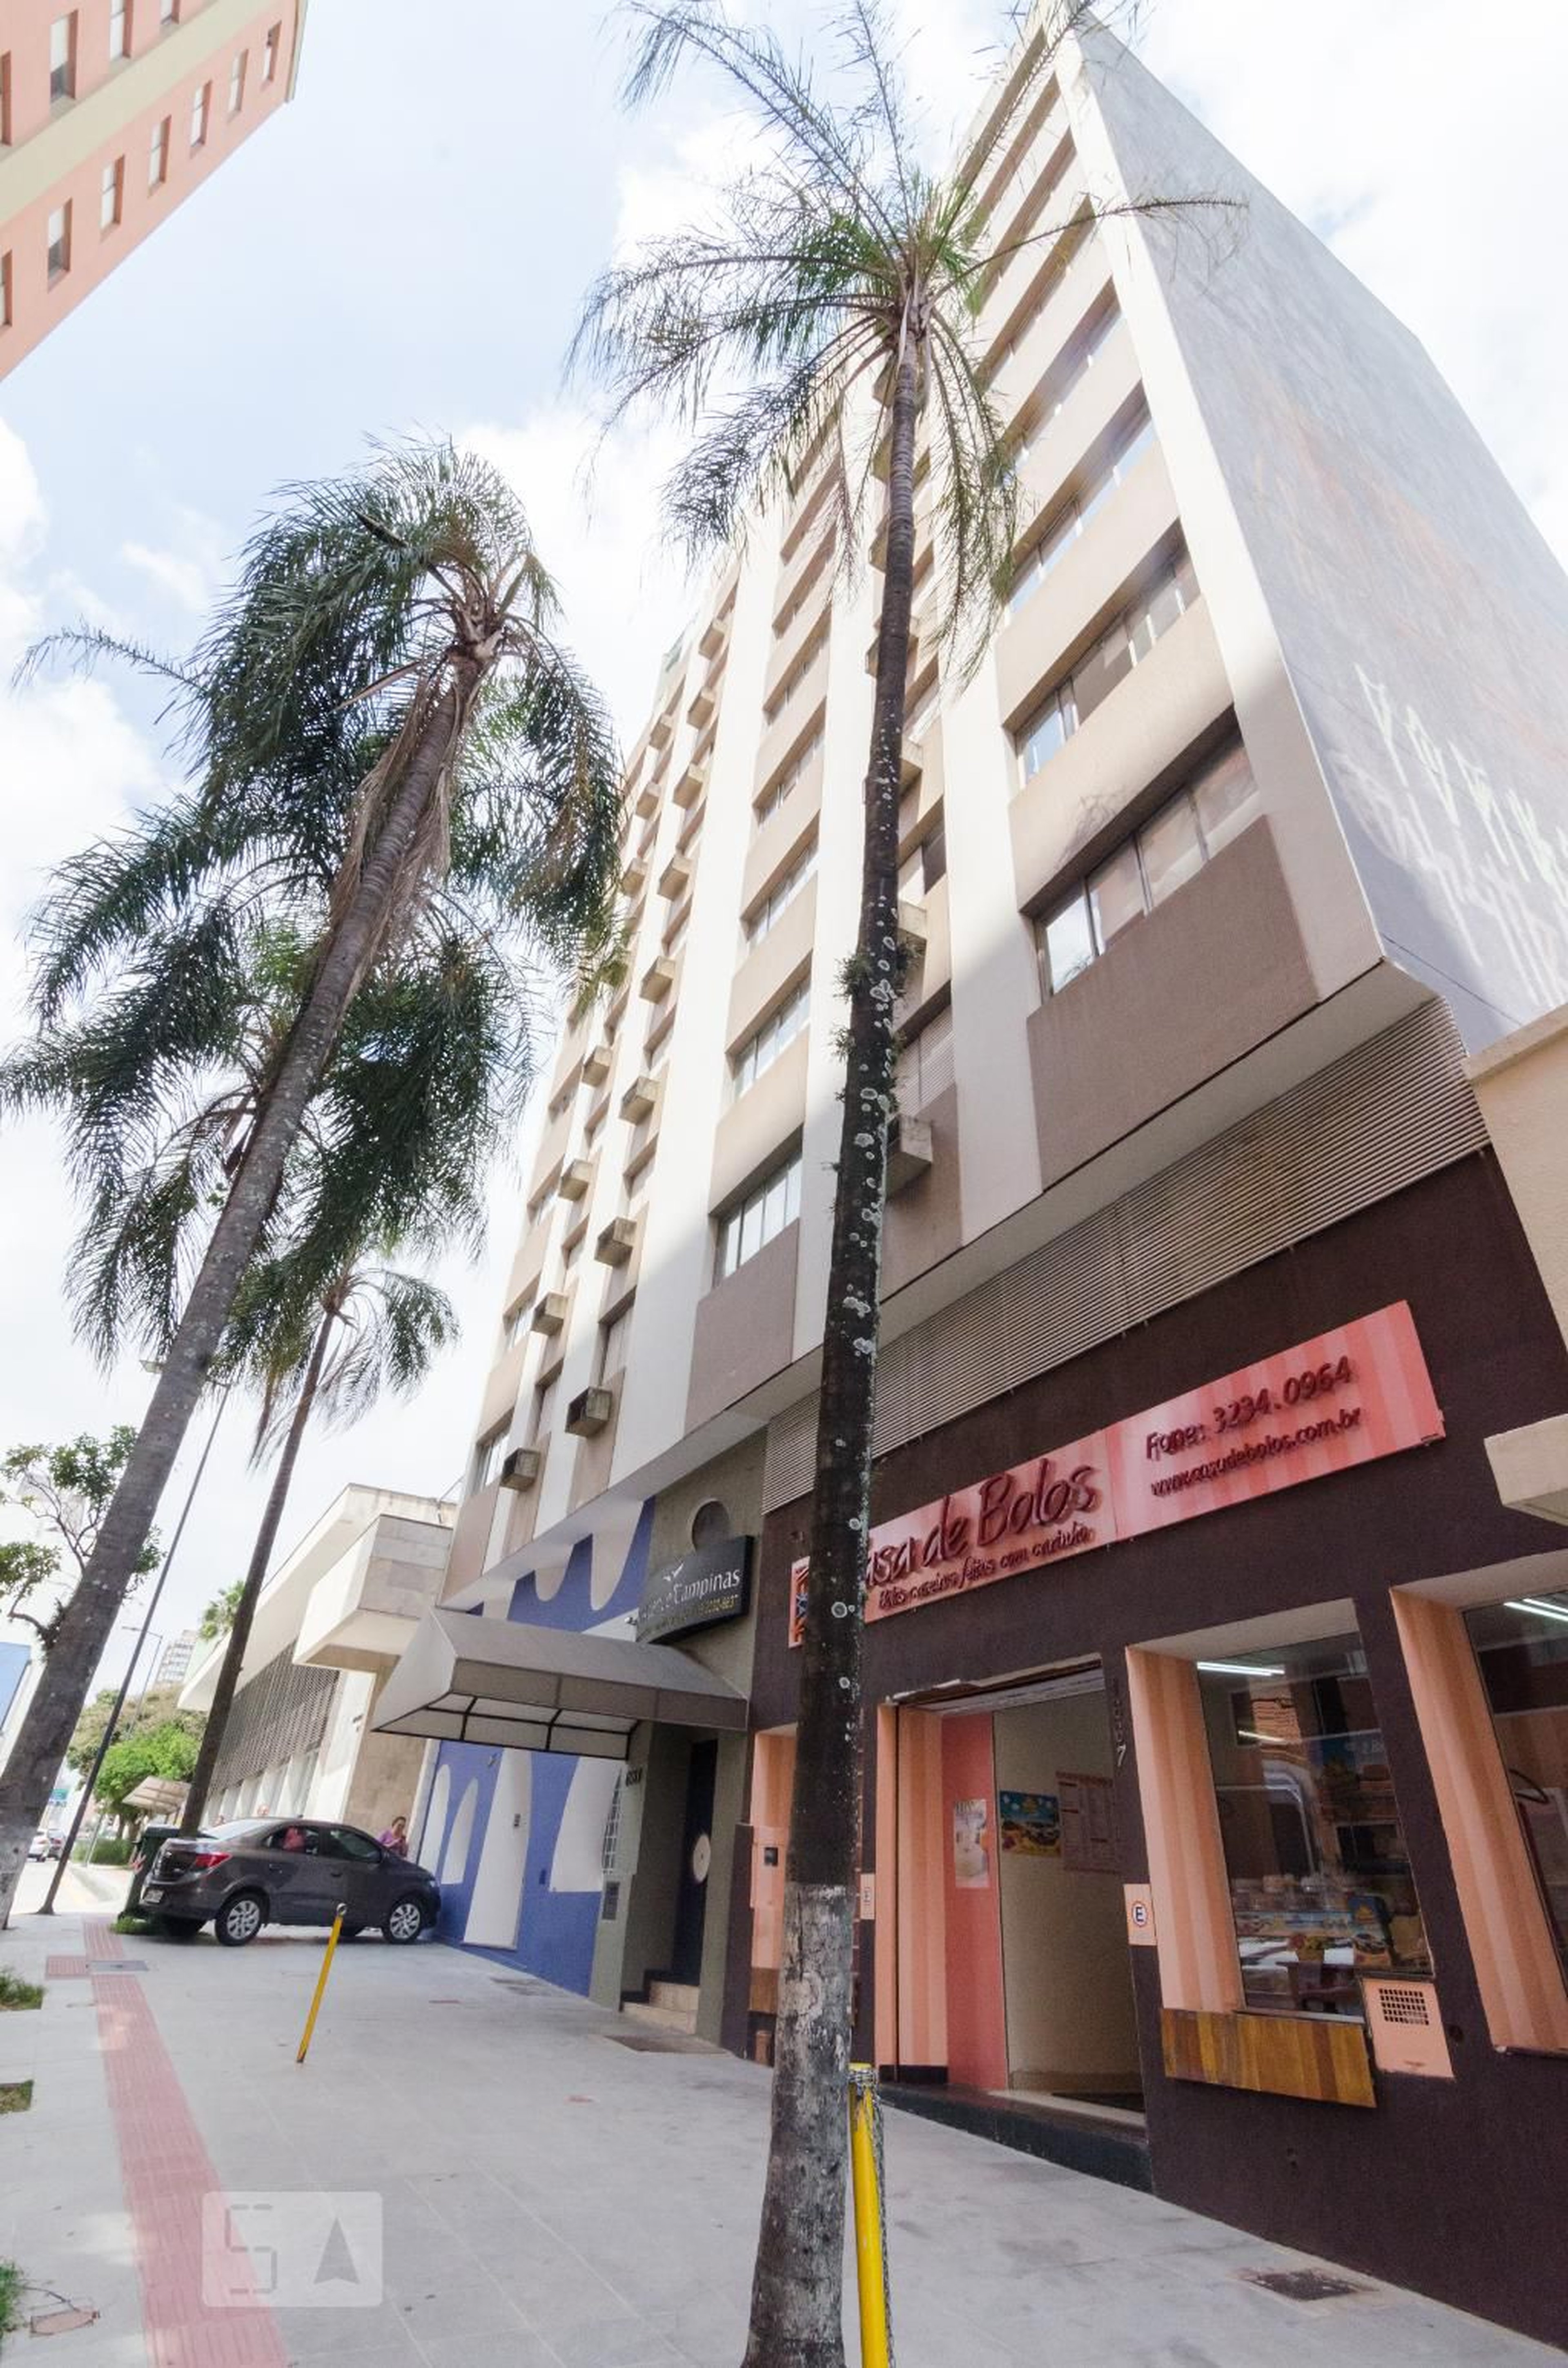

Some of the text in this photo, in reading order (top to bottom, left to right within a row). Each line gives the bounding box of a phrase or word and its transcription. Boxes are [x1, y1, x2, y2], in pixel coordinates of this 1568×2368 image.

[1213, 1356, 1355, 1433] 3234.0964
[923, 1495, 969, 1567] de
[978, 1458, 1099, 1547] Bolos
[674, 1569, 741, 1604] Campinas
